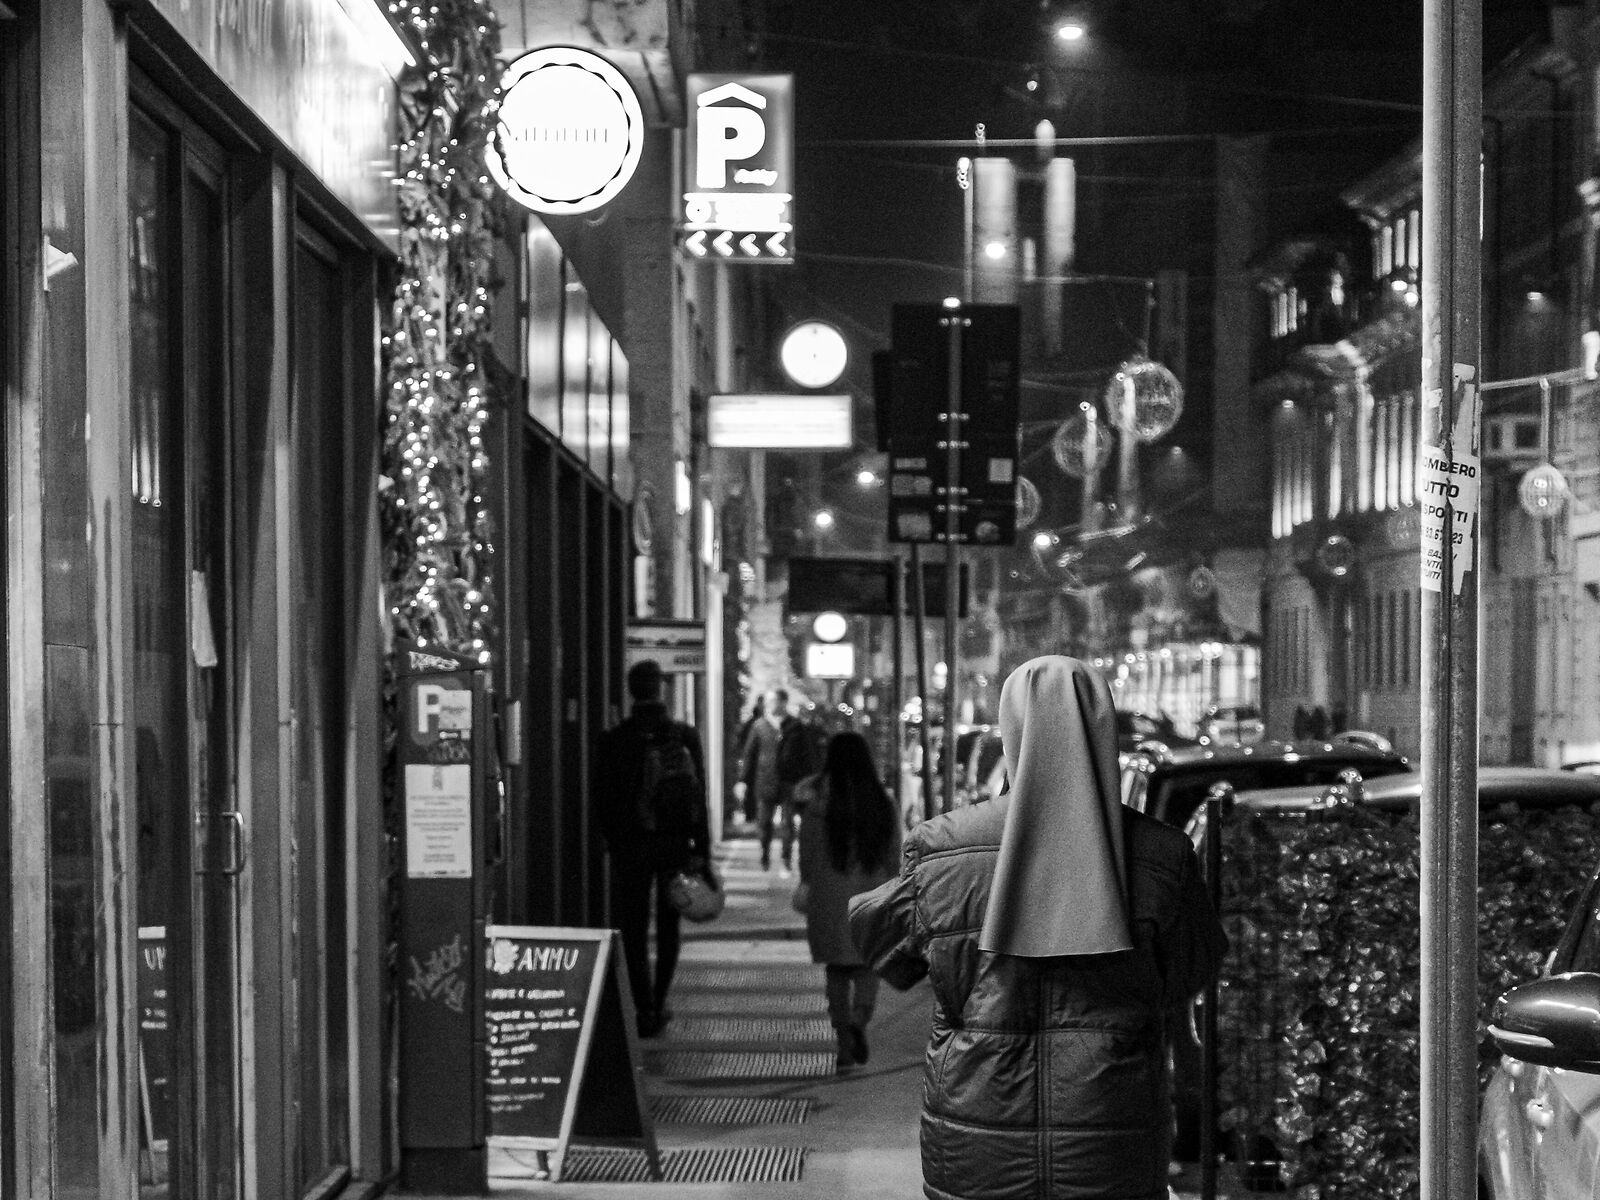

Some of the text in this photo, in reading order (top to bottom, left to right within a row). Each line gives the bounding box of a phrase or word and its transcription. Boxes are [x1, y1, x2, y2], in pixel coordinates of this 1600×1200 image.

[697, 107, 766, 188] P
[1424, 504, 1468, 523] SPOTI
[518, 947, 579, 971] AMMU
